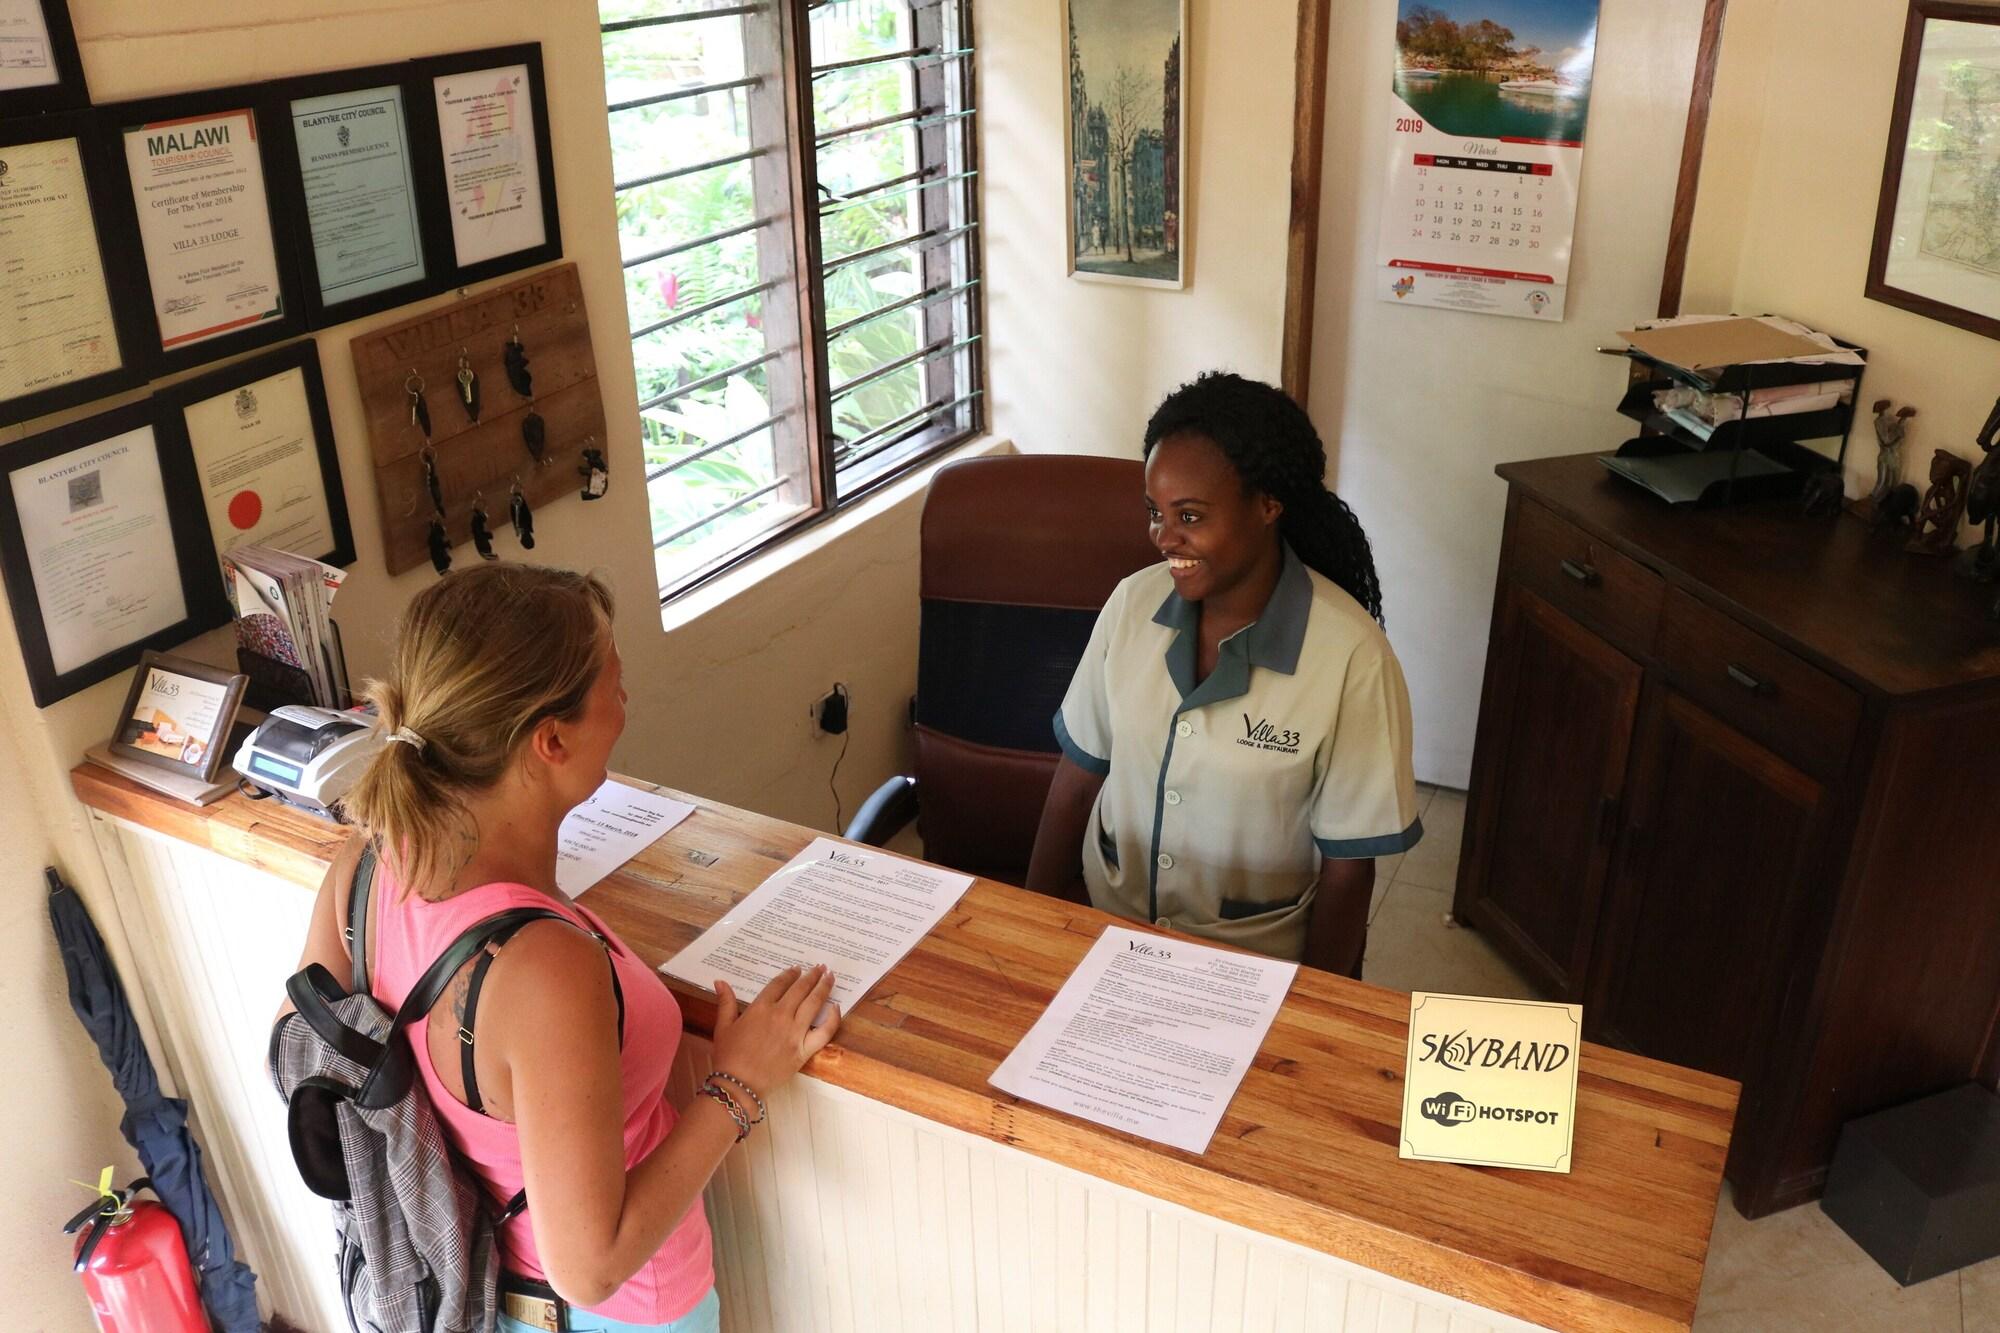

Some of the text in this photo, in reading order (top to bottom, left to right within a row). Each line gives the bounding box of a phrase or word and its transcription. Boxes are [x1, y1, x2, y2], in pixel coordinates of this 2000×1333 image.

[302, 106, 386, 128] BLANTYRE CITY COUNCIL
[1396, 118, 1423, 134] 2019
[147, 125, 230, 156] MALAWI
[1463, 142, 1498, 155] March
[152, 153, 189, 167] TOURISM
[195, 147, 230, 160] COUNCIL
[1520, 176, 1523, 184] 1
[151, 183, 245, 209] Certificate of Membership
[1458, 186, 1462, 194] 5
[167, 196, 233, 216] For The Year 2018
[1454, 202, 1463, 210] 12
[1474, 204, 1483, 212] 13
[1493, 205, 1502, 213] 14
[1513, 208, 1522, 216] 15
[1533, 209, 1542, 218] 16
[1434, 216, 1442, 224] 18
[1472, 219, 1482, 227] 20
[1491, 221, 1500, 229] 21
[1510, 223, 1521, 231] 22
[1530, 225, 1540, 233] 23
[172, 228, 240, 251] VILLA 33 LODGE
[1412, 229, 1422, 237] 24
[1489, 236, 1499, 245] 28
[1509, 238, 1519, 246] 29
[38, 446, 128, 484] BLANTYRE CITY COUNCIL
[1236, 738, 1255, 748] LODGE
[1263, 744, 1300, 754] RESTAURANT
[1419, 1028, 1570, 1072] SKYBAND
[1479, 1106, 1559, 1125] HOTSPOT
